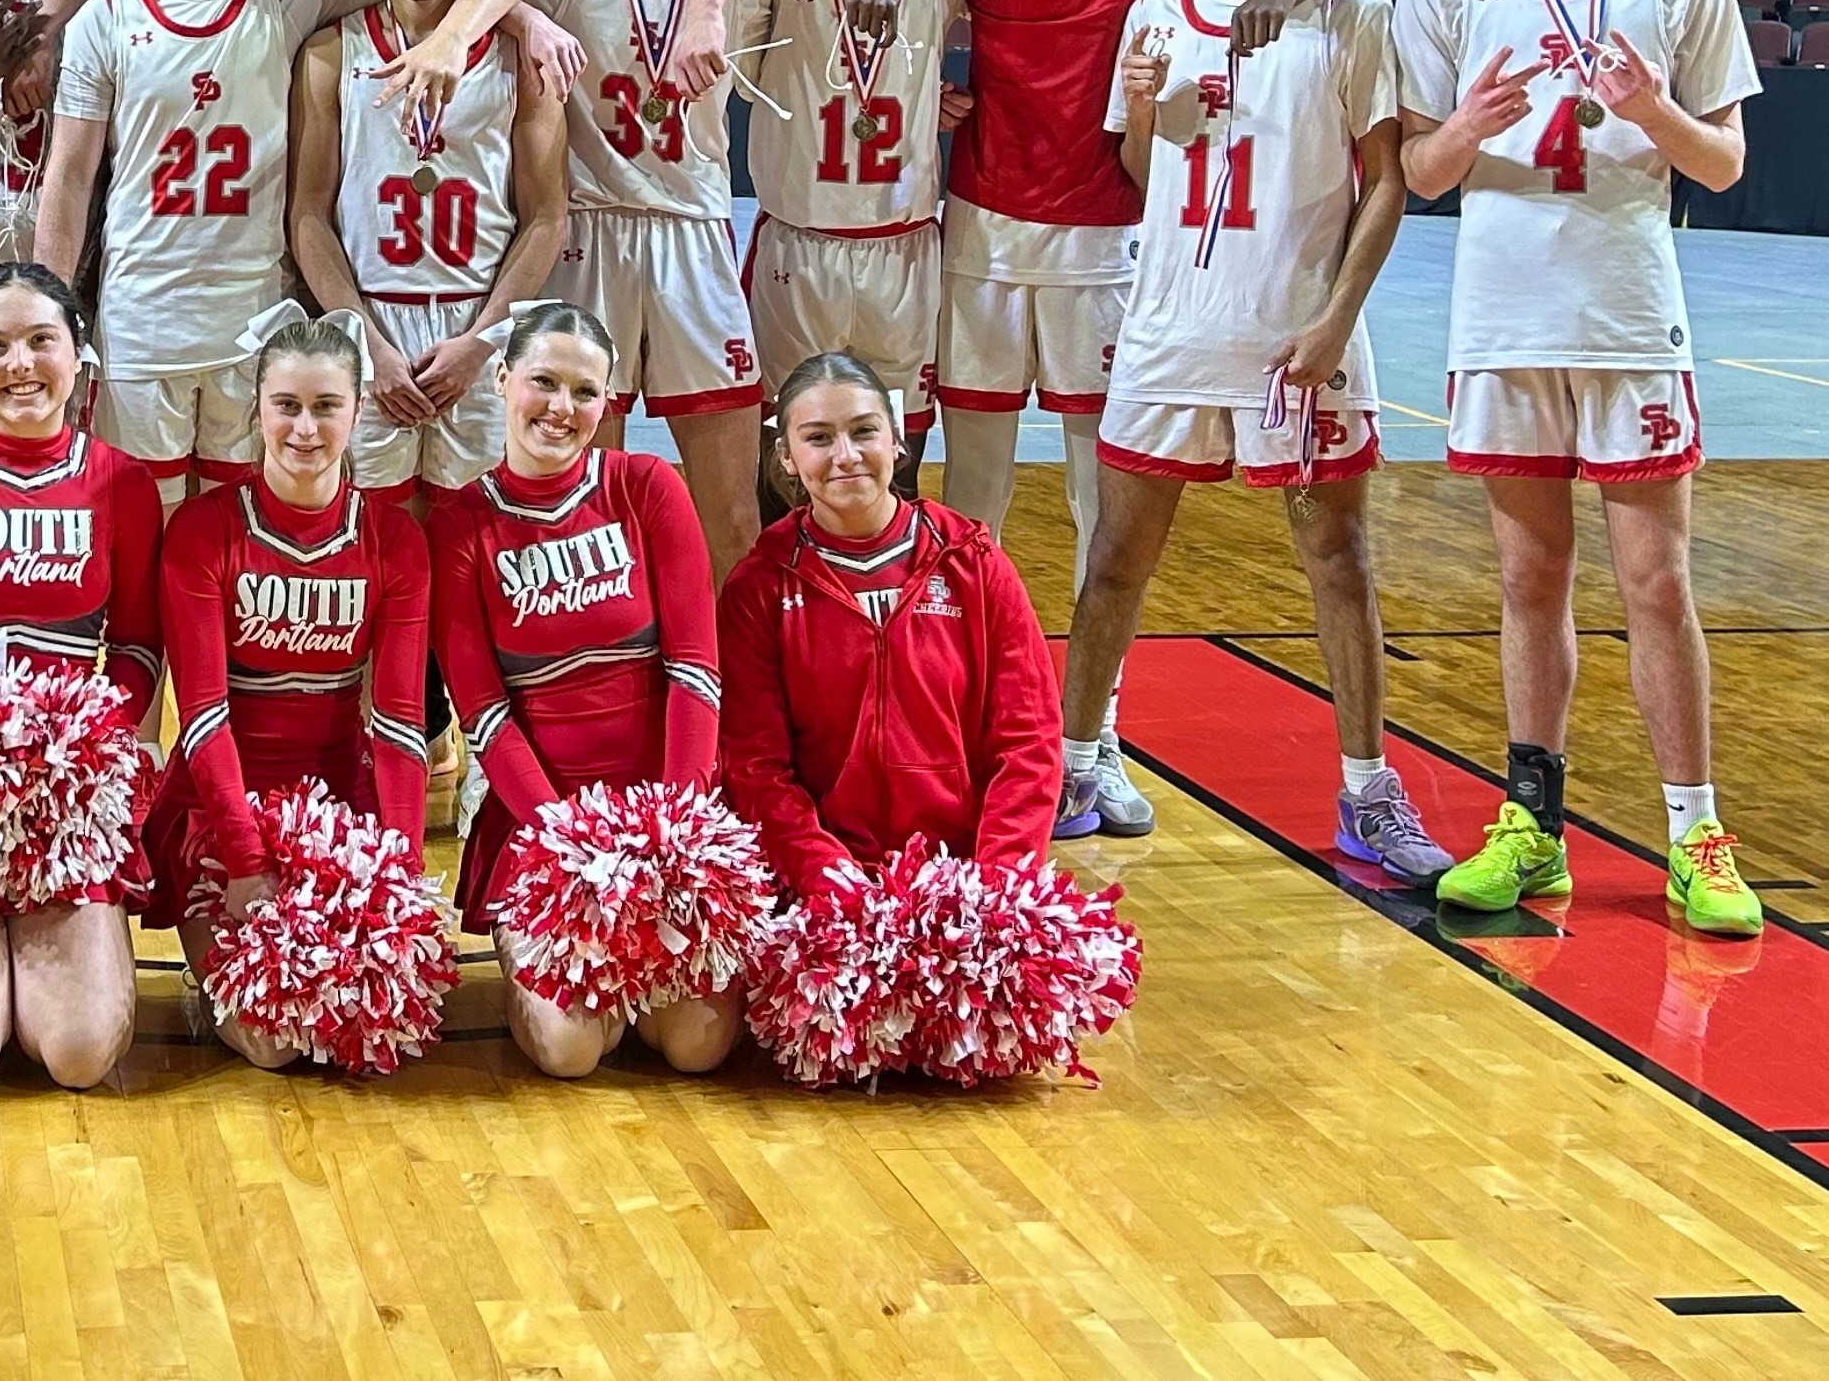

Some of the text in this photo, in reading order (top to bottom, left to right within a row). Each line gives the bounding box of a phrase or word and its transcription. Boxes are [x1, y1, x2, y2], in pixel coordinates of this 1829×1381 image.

[148, 123, 252, 219] 22
[816, 94, 904, 185] 12
[1179, 132, 1258, 232] 11
[1532, 94, 1588, 195] 4
[376, 173, 480, 269] 30
[234, 572, 368, 627] SOUTH
[496, 522, 633, 599] SOUTH
[510, 561, 635, 628] Portland
[231, 616, 364, 655] Portland
